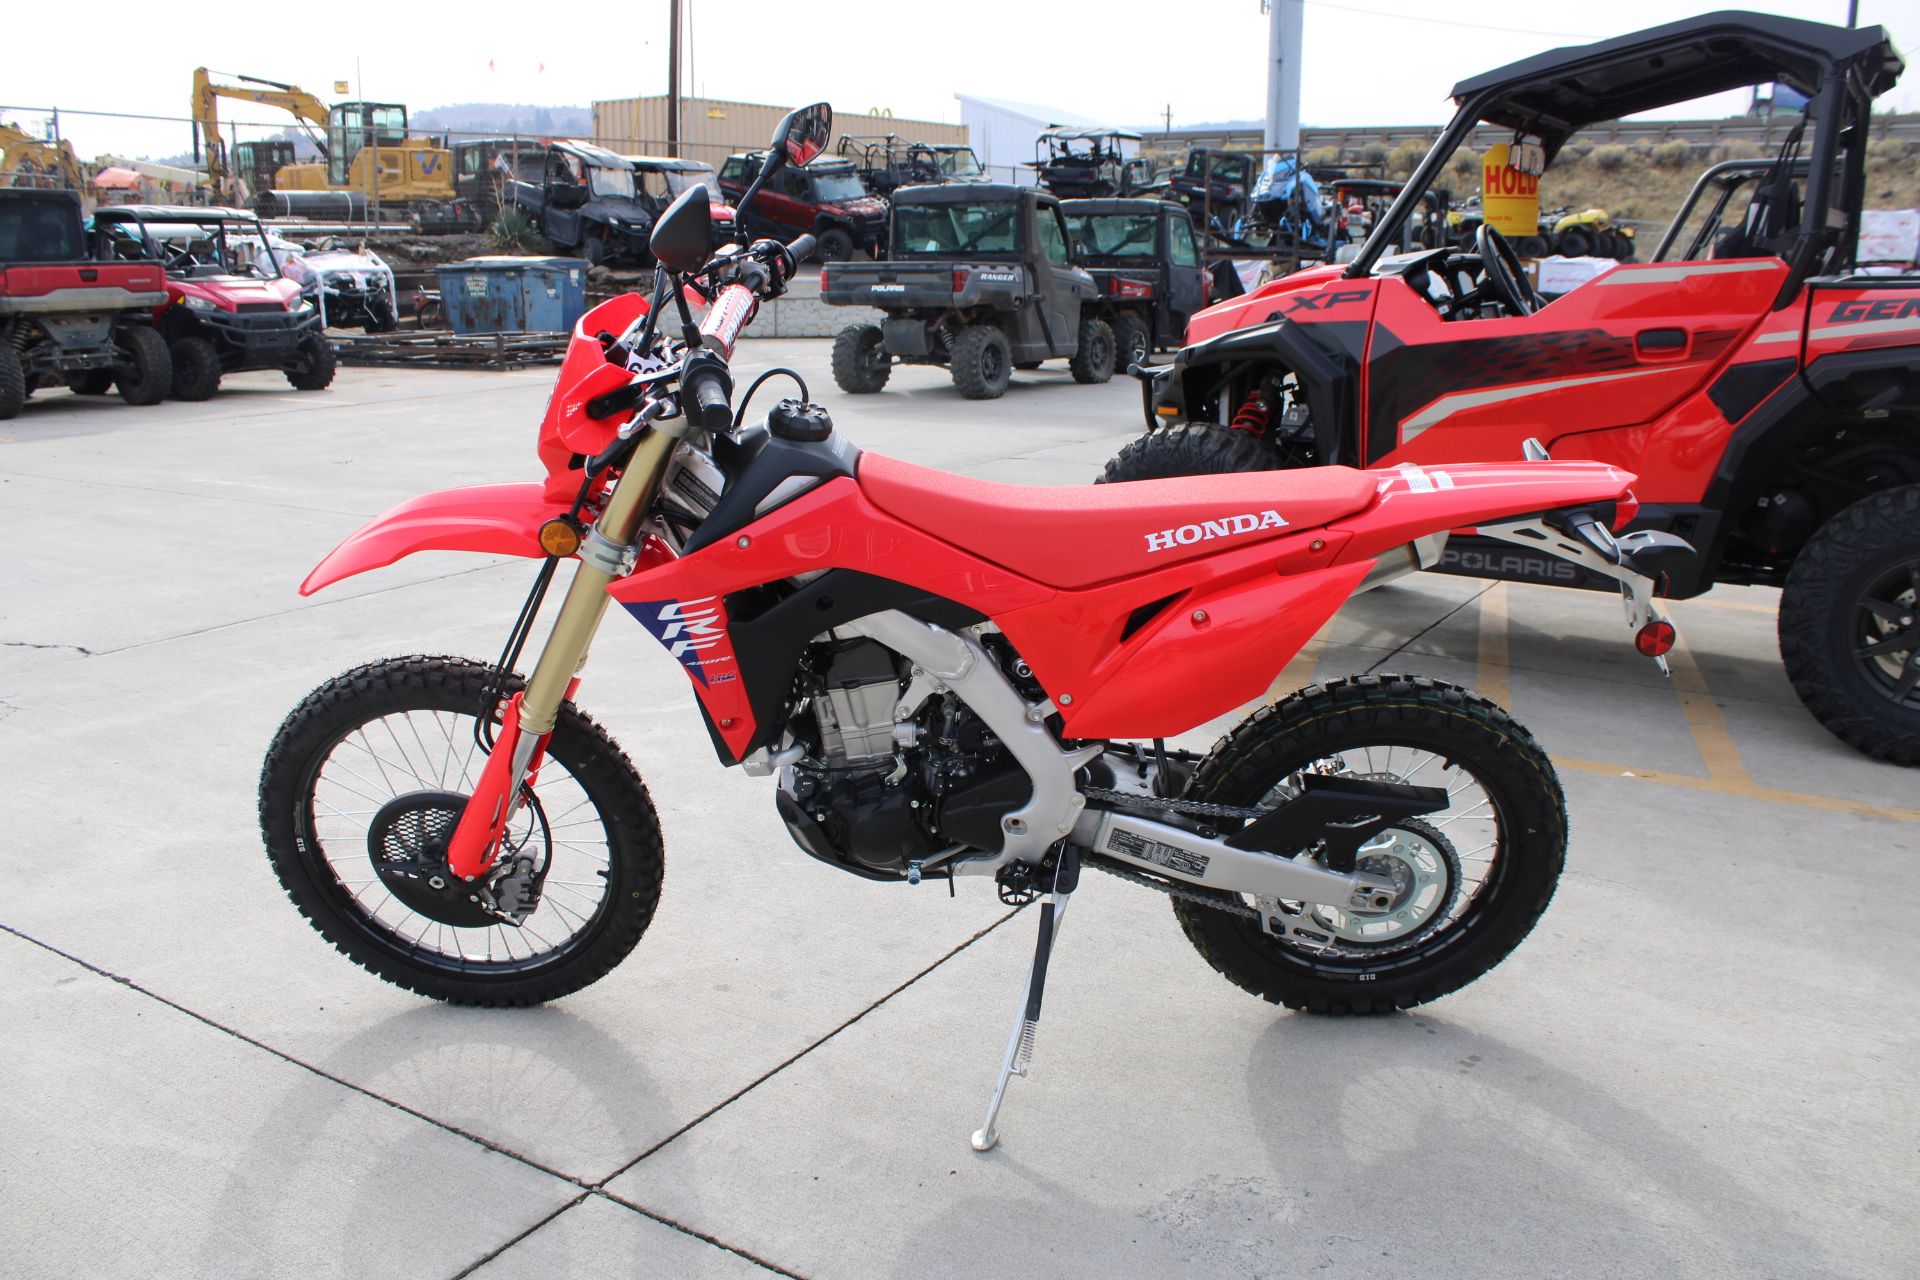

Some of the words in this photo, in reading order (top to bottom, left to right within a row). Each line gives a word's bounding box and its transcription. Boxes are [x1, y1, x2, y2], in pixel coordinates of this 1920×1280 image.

[1485, 165, 1537, 195] HOLD
[980, 273, 1015, 281] RANGER
[1284, 290, 1373, 314] XP
[1145, 510, 1290, 553] HONDA
[1440, 551, 1576, 579] POLARIS
[657, 595, 725, 658] CRF
